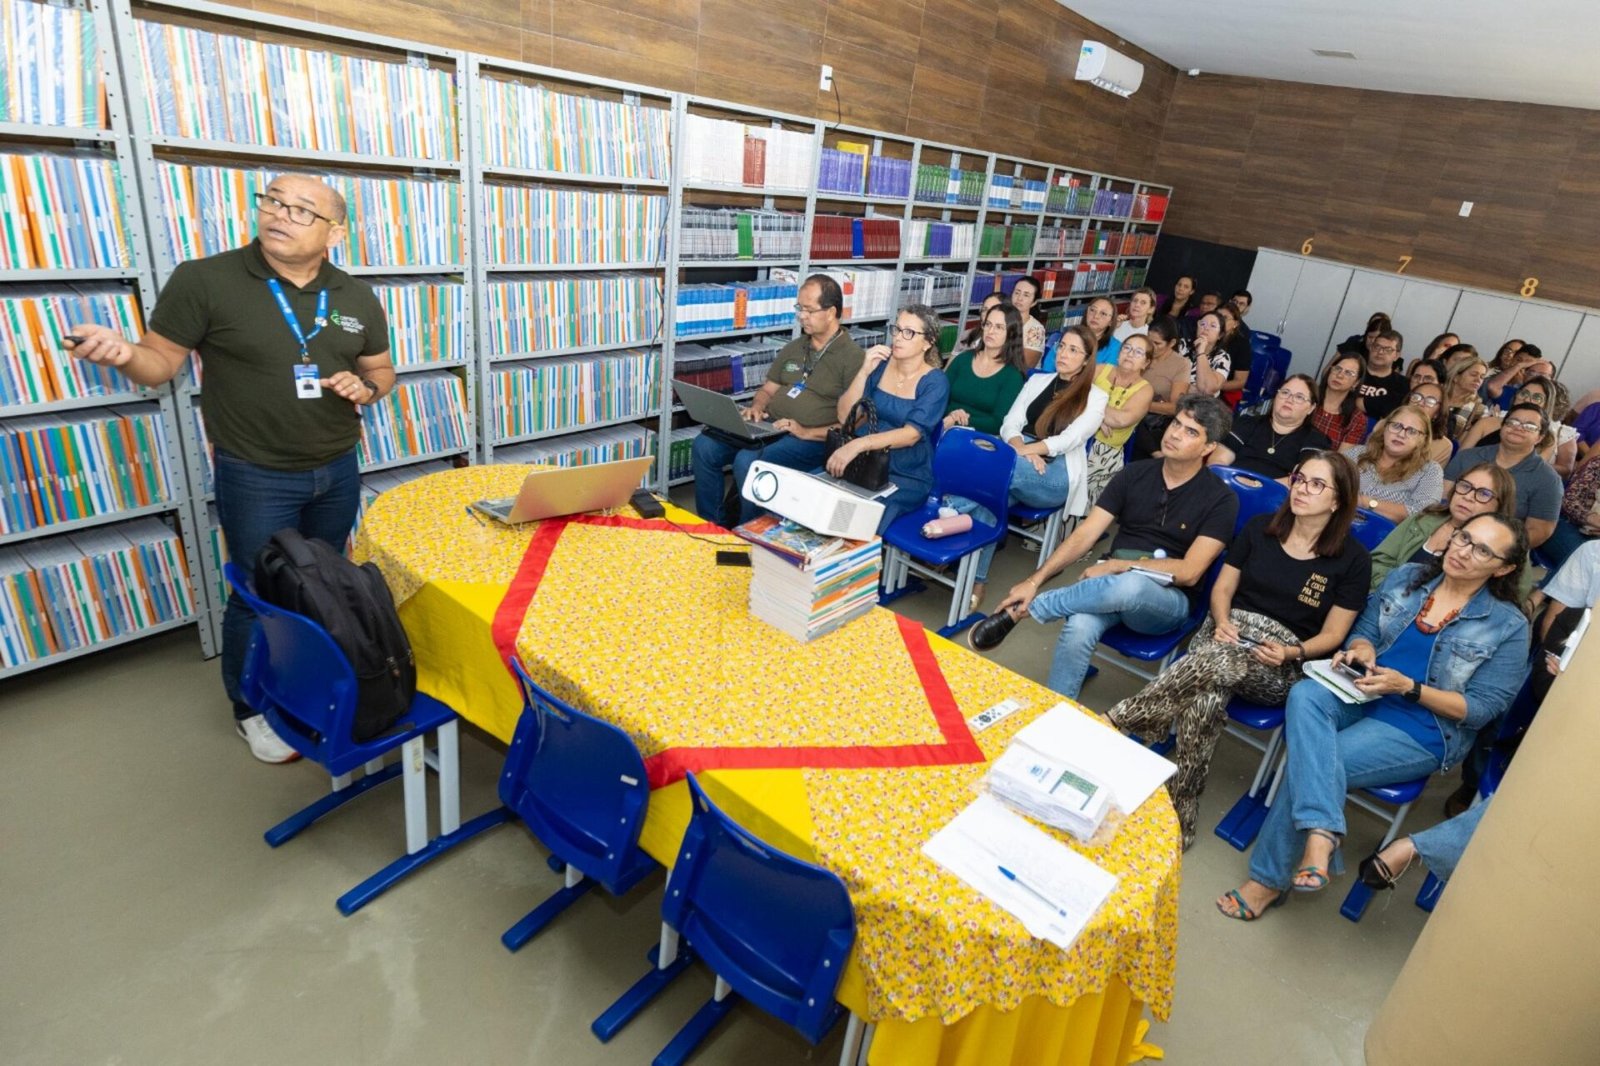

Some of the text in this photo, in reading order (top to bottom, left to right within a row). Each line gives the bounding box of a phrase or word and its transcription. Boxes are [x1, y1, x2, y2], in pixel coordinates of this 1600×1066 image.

[1301, 237, 1314, 255] 6
[1397, 255, 1412, 273] 7
[1520, 277, 1538, 297] 8
